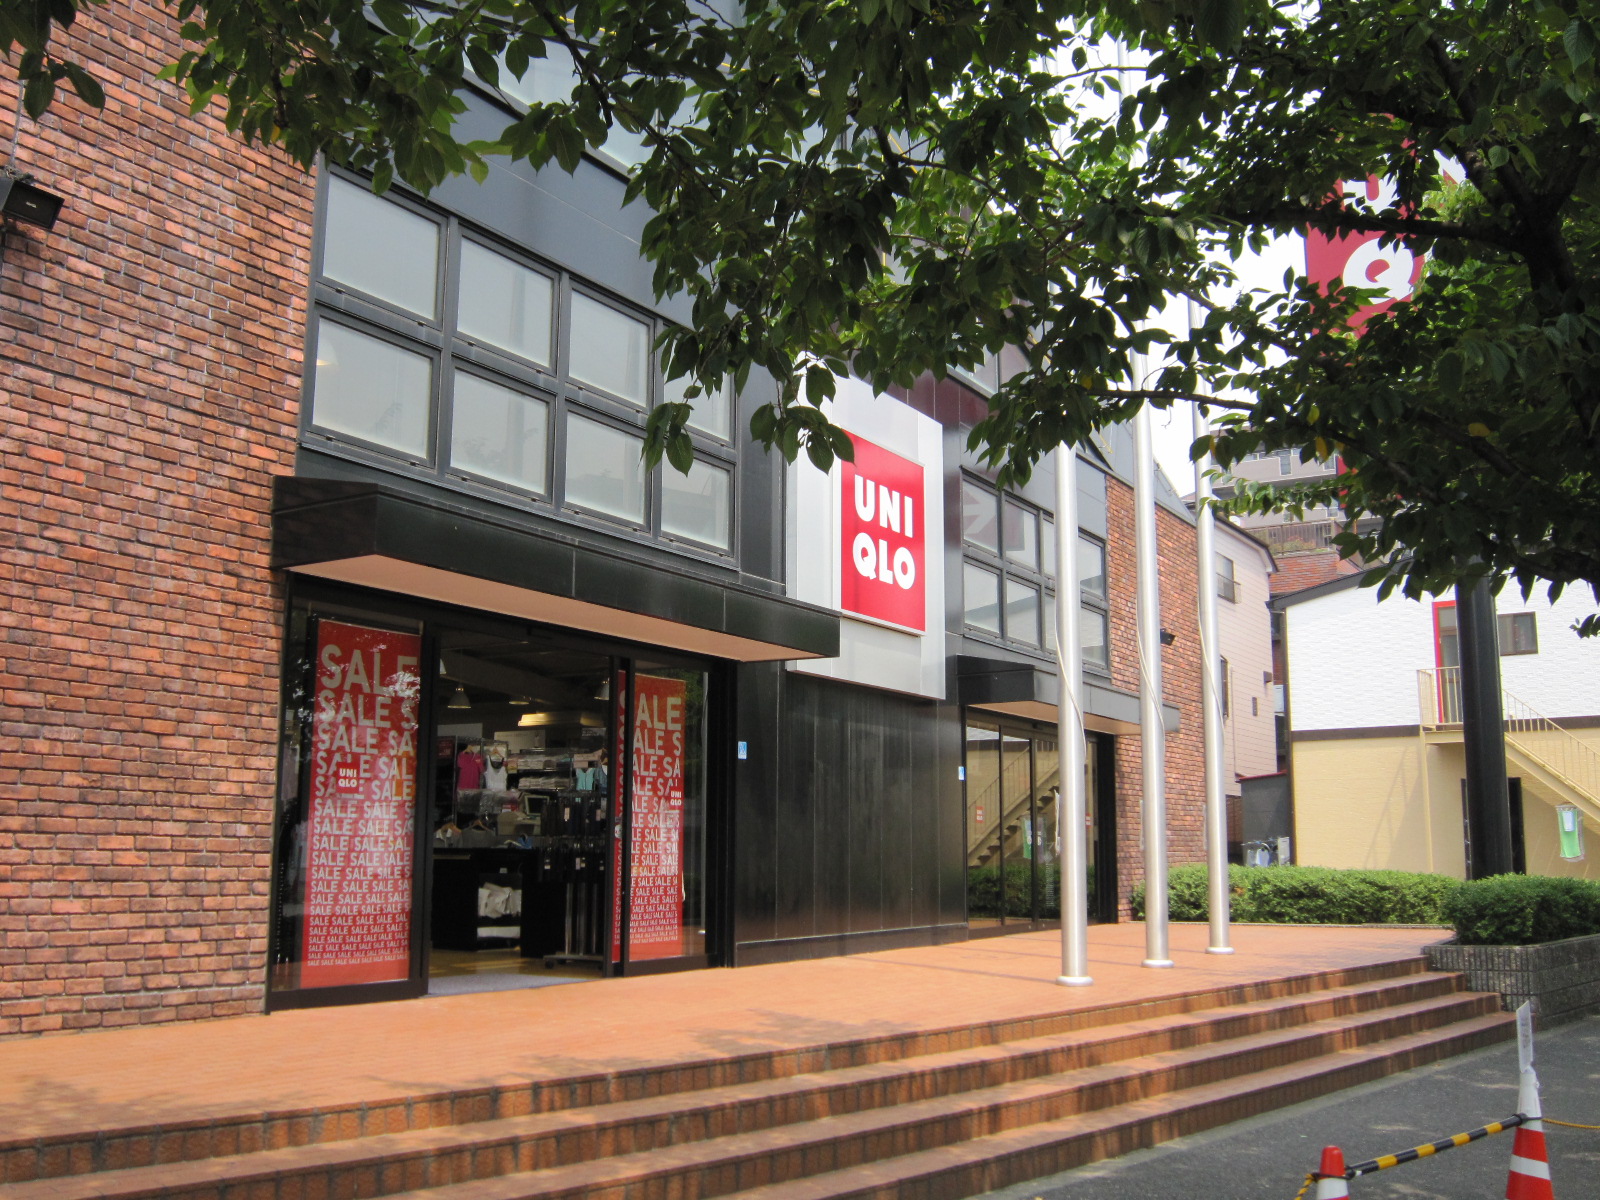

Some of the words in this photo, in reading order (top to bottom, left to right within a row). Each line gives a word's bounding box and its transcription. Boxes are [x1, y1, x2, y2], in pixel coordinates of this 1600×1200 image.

[854, 473, 913, 539] UNI
[852, 532, 916, 590] QLO
[321, 644, 418, 697] SALE
[319, 689, 391, 729] SALE
[317, 722, 378, 755] SALE
[388, 730, 415, 757] SA
[340, 768, 357, 777] UNI
[378, 756, 413, 779] SAL
[338, 779, 358, 787] QLO
[371, 780, 413, 800] SALE
[314, 798, 358, 818] SALE
[363, 801, 399, 819] SALE
[313, 817, 352, 835] SALE
[358, 820, 390, 836] SALE
[312, 835, 349, 851] SALE
[354, 837, 385, 852] SALE
[388, 836, 411, 851] SAL
[312, 852, 345, 866] SALE
[350, 852, 383, 866] SALE
[384, 852, 410, 866] SALE
[312, 867, 341, 879] SALE
[346, 867, 374, 879] SALE
[378, 867, 402, 879] SALE
[311, 881, 338, 893] SALE
[342, 881, 369, 893] SALE
[372, 880, 394, 891] SALE
[310, 894, 334, 904] SALE
[338, 893, 363, 904] SALE
[366, 893, 386, 903] SALE
[388, 891, 409, 902] SALE
[310, 905, 332, 915] SALE
[335, 905, 359, 915] SALE
[361, 904, 381, 914] SALE
[383, 903, 402, 914] SALE
[310, 916, 330, 926] SALE
[331, 916, 354, 926] SALE
[356, 915, 374, 925] SALE
[309, 926, 327, 935] SALE
[330, 926, 348, 935] SALE
[351, 925, 368, 934] SALE
